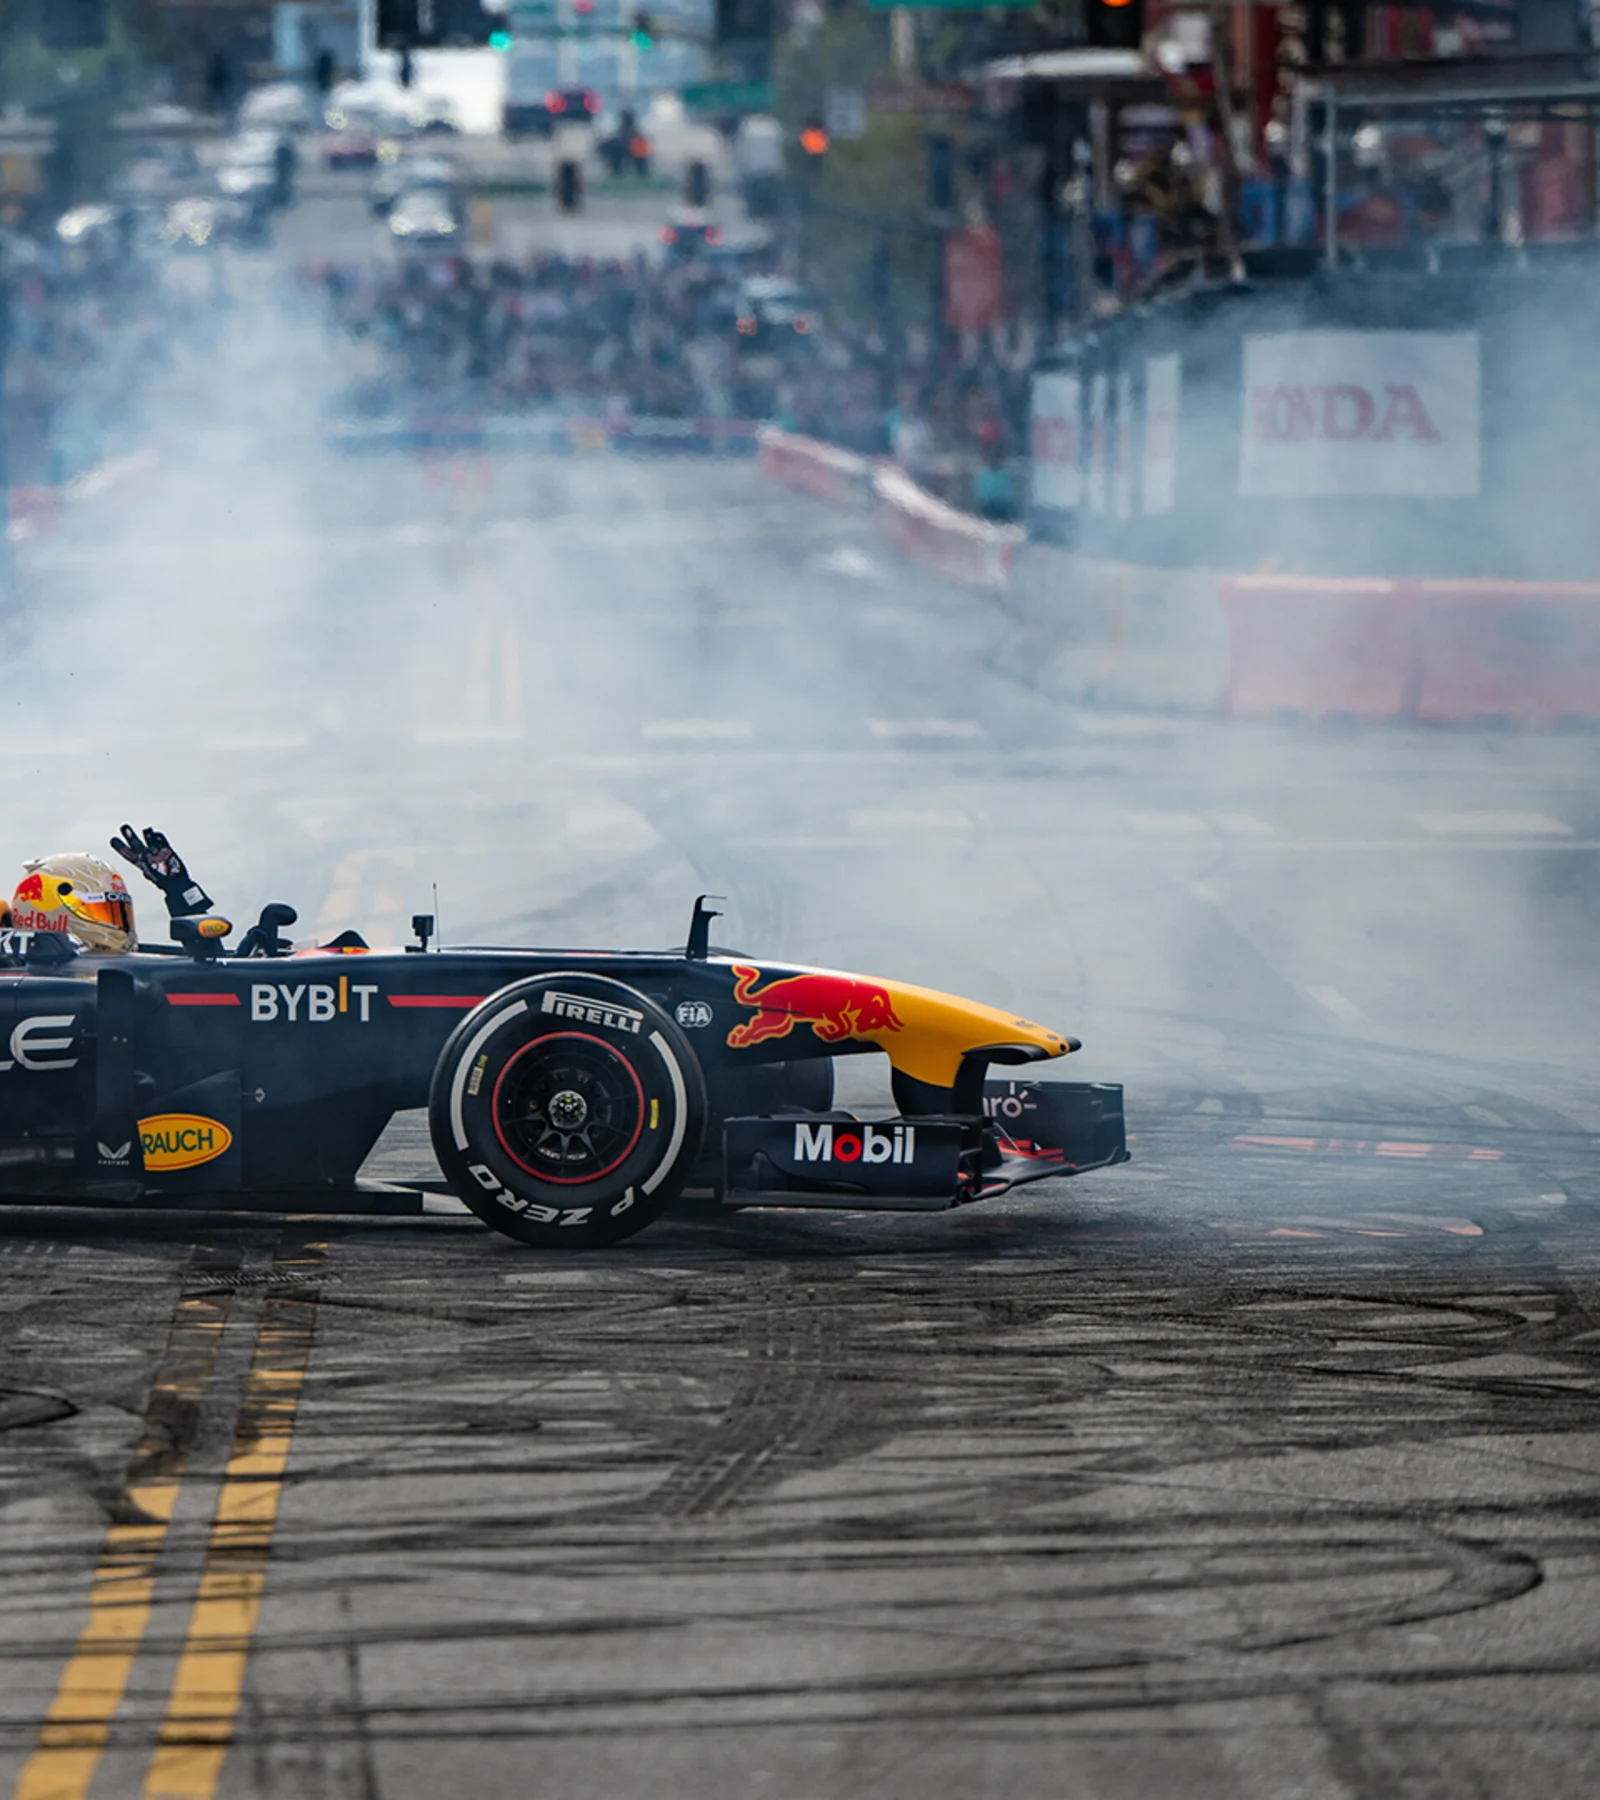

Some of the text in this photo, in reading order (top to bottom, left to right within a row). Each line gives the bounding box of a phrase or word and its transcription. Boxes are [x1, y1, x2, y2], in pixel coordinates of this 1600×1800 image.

[36, 912, 69, 933] Bull
[251, 976, 379, 1022] BYBIT
[541, 991, 644, 1034] PIRELLI
[677, 1003, 710, 1026] FIA
[141, 1128, 214, 1155] RAUCH
[794, 1123, 915, 1164] Mobil
[468, 1163, 594, 1227] ZERO
